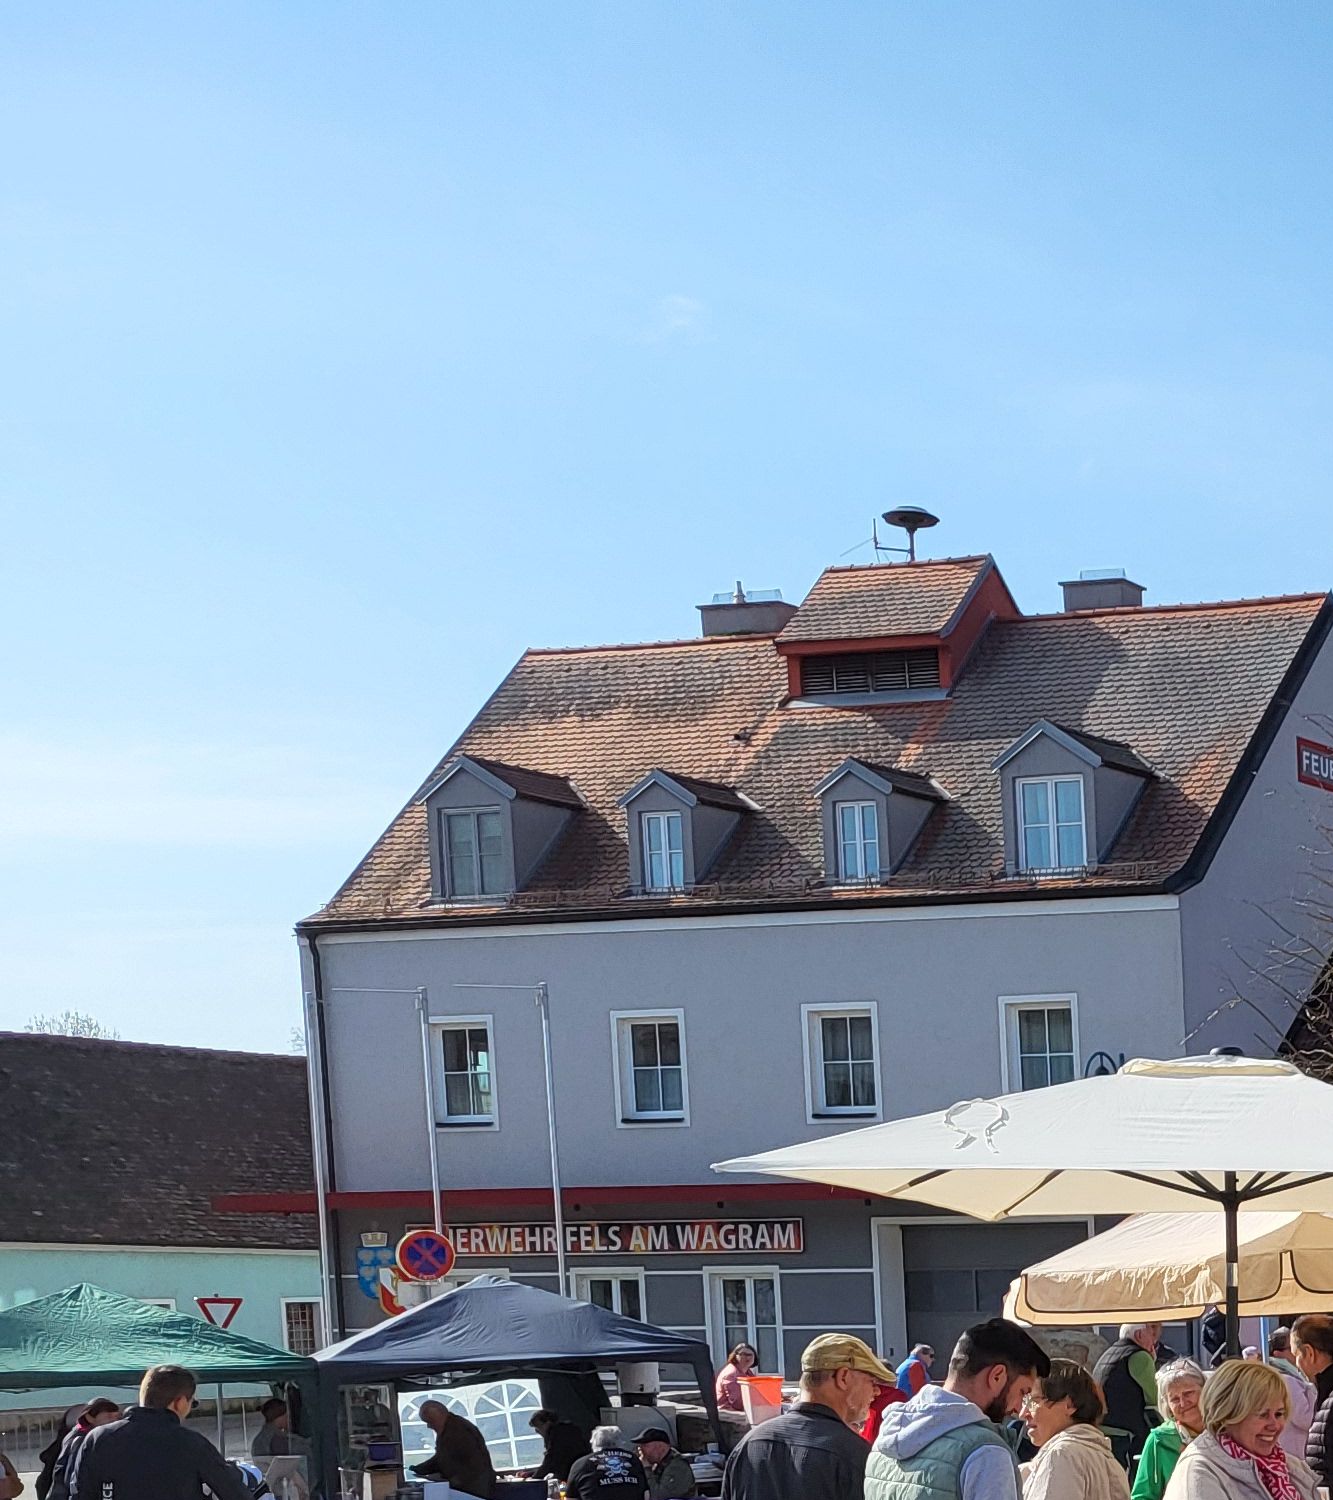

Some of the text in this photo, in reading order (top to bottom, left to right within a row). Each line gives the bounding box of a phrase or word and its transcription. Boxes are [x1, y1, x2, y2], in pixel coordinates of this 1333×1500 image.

[565, 1224, 621, 1252] FELS
[628, 1224, 669, 1251] AM
[675, 1222, 797, 1251] WAGRAM
